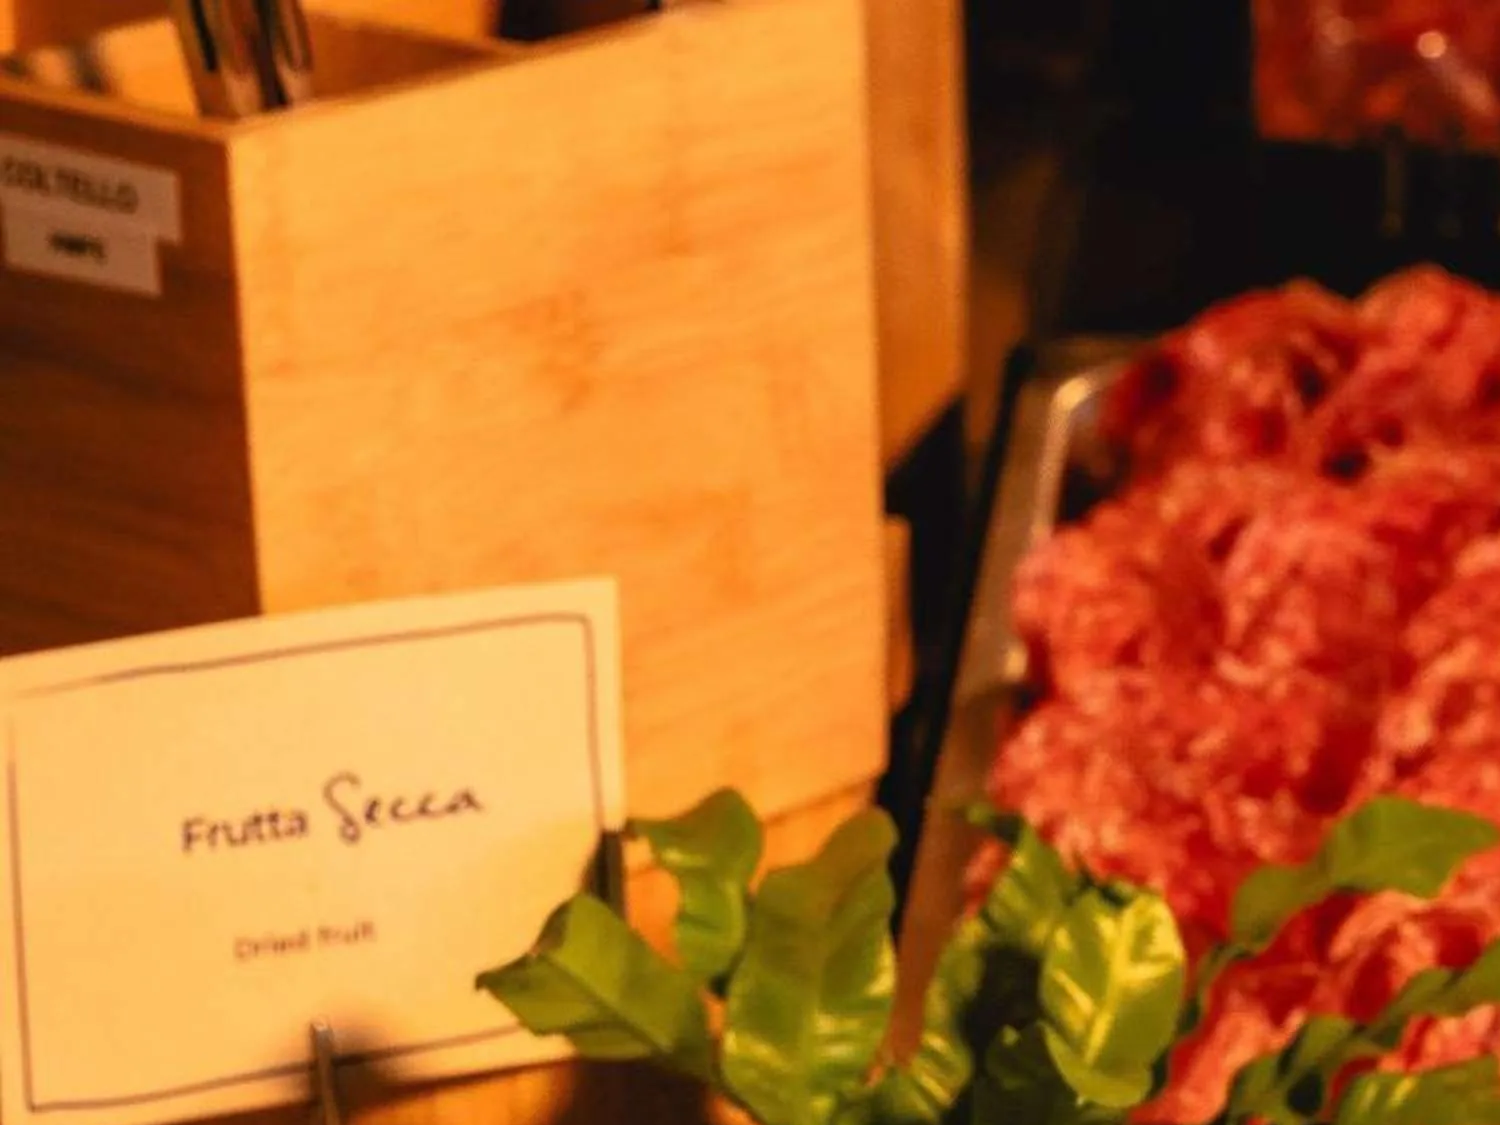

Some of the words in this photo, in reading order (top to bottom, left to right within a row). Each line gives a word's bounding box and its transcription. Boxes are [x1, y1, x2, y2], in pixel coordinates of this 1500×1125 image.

[181, 809, 308, 853] Frutta
[321, 771, 485, 844] Secca
[234, 930, 310, 960] Dried
